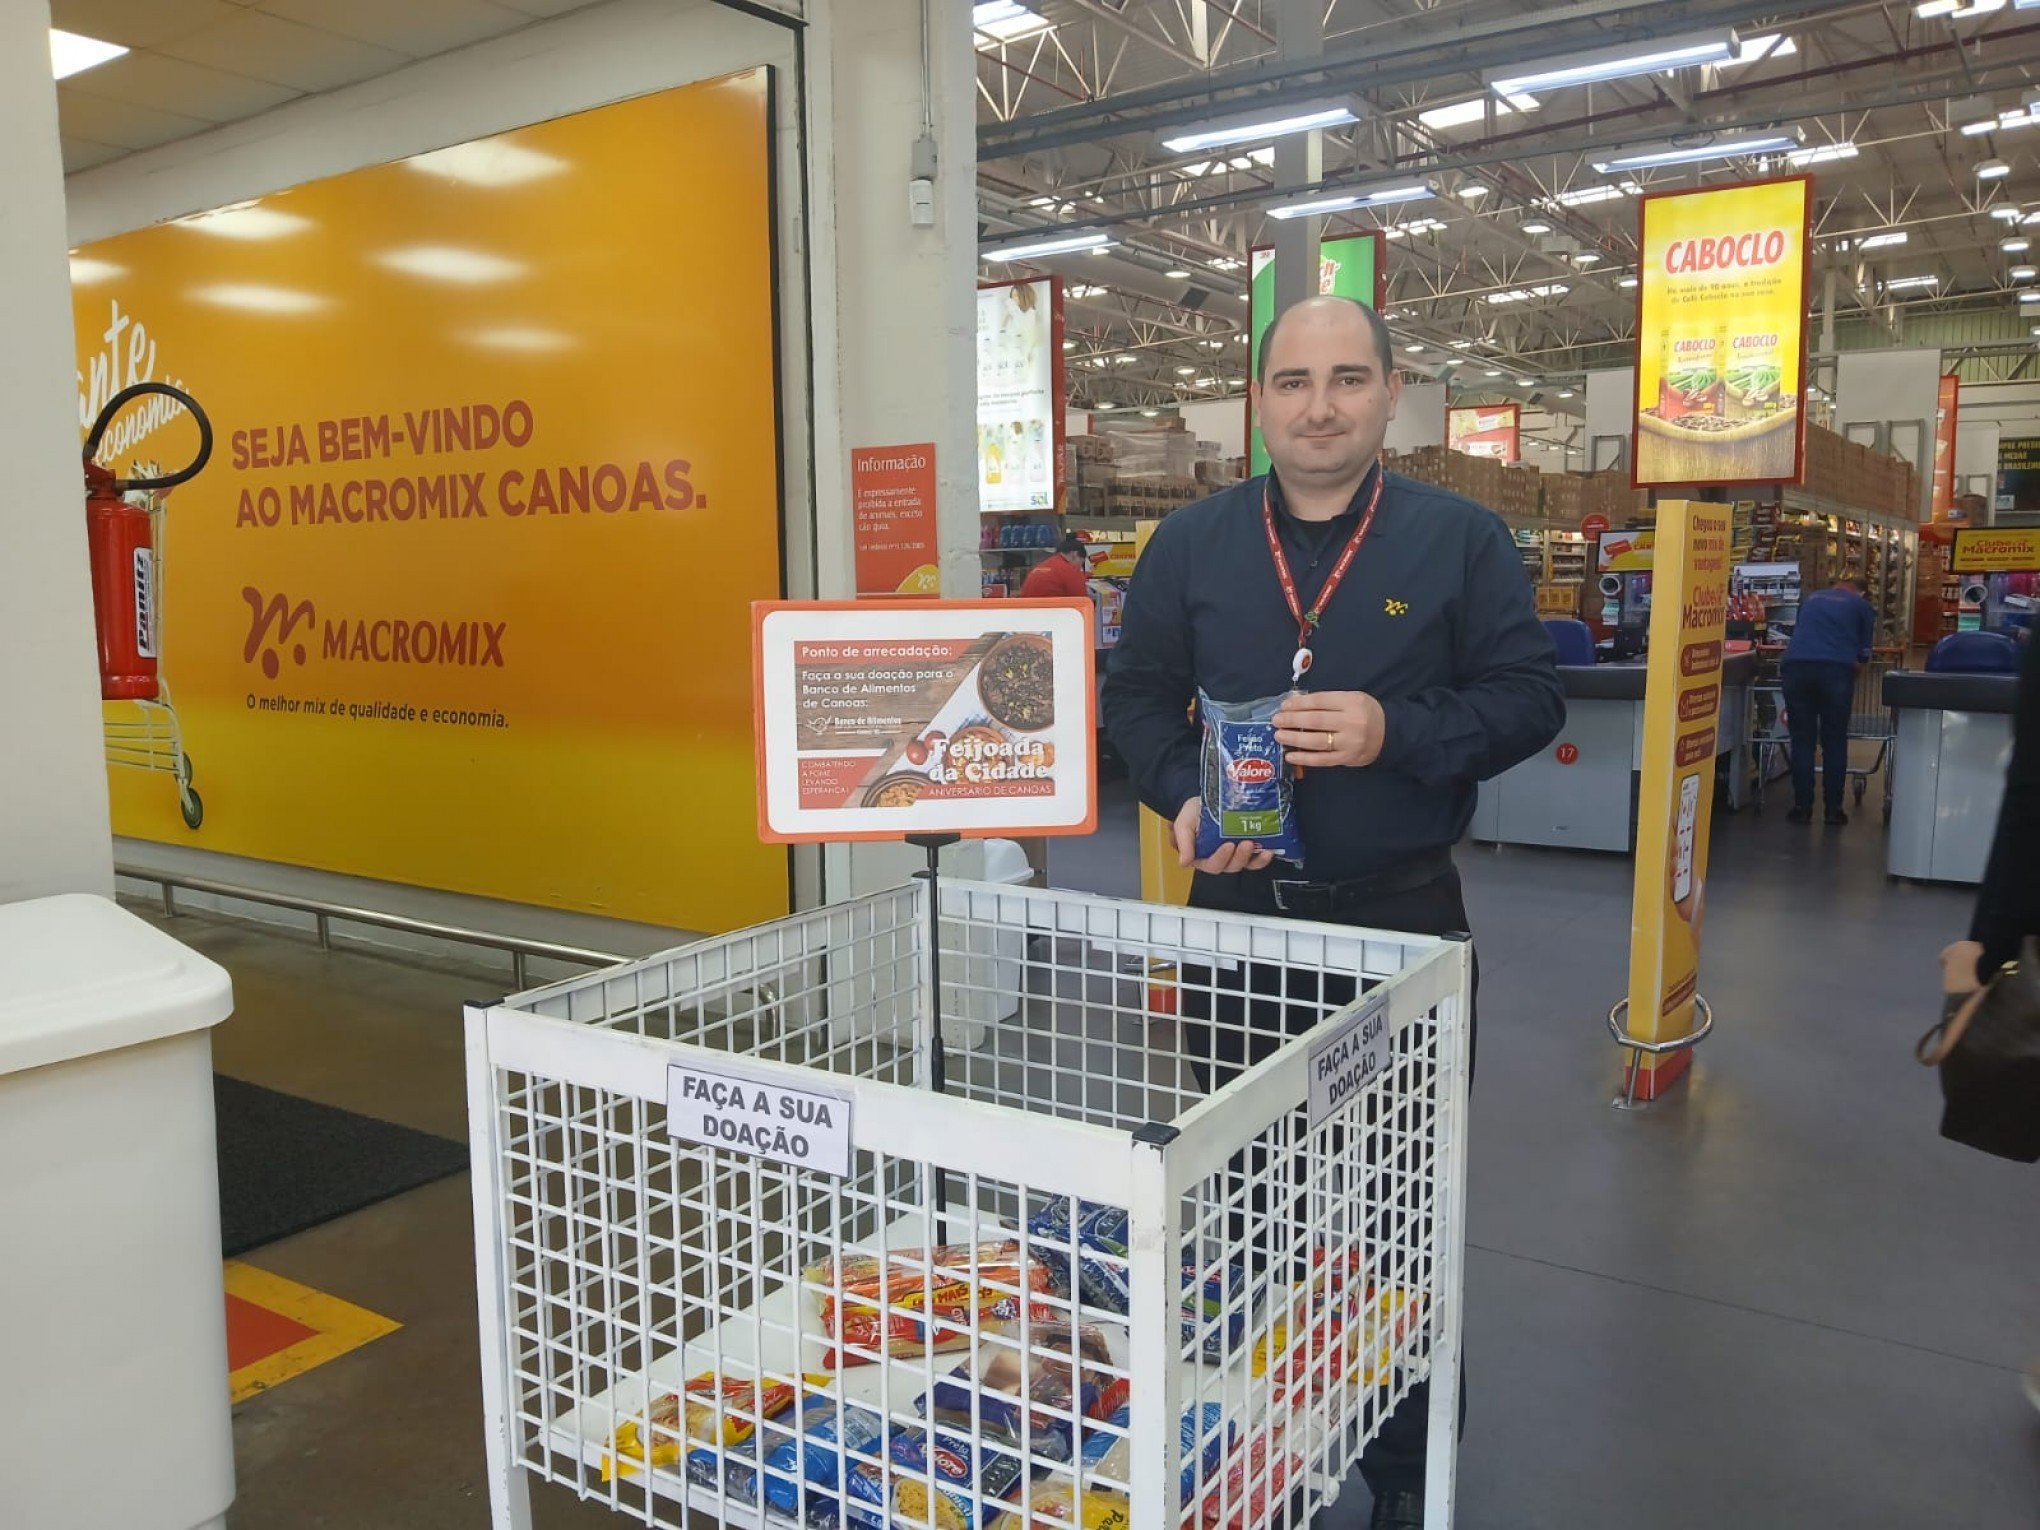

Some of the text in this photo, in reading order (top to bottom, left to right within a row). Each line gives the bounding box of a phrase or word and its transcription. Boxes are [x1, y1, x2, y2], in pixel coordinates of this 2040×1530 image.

[1665, 229, 1785, 274] CABOCLO
[1674, 338, 1716, 353] CABOCLO
[1732, 334, 1777, 349] CABOCLO
[231, 400, 534, 470] SEJA BEM-VINDO
[857, 454, 926, 472] Informação
[235, 459, 707, 528] AO MACROMIX CANOAS.
[1962, 545, 2035, 554] Macromix
[322, 619, 506, 667] MACROMIX
[802, 645, 952, 658] Ponto de arrecadação:
[802, 669, 954, 682] Faça a sua doação para o
[802, 683, 916, 695] Banco de Alimentos
[246, 693, 509, 729] O melhor mix de qualidade e economia.
[803, 699, 818, 709] de
[930, 736, 1045, 762] Feijoada
[1560, 747, 1575, 758] 17
[928, 760, 1048, 784] da Cidade
[1229, 763, 1272, 778] Valore
[994, 786, 1006, 795] DE
[1008, 784, 1052, 795] CANOAS
[1318, 1014, 1382, 1081] FAÇA A SUA
[1329, 1051, 1376, 1105] DOAÇÃO
[683, 1076, 832, 1128] FAÇA A SUA
[703, 1115, 809, 1158] DOAÇÃO
